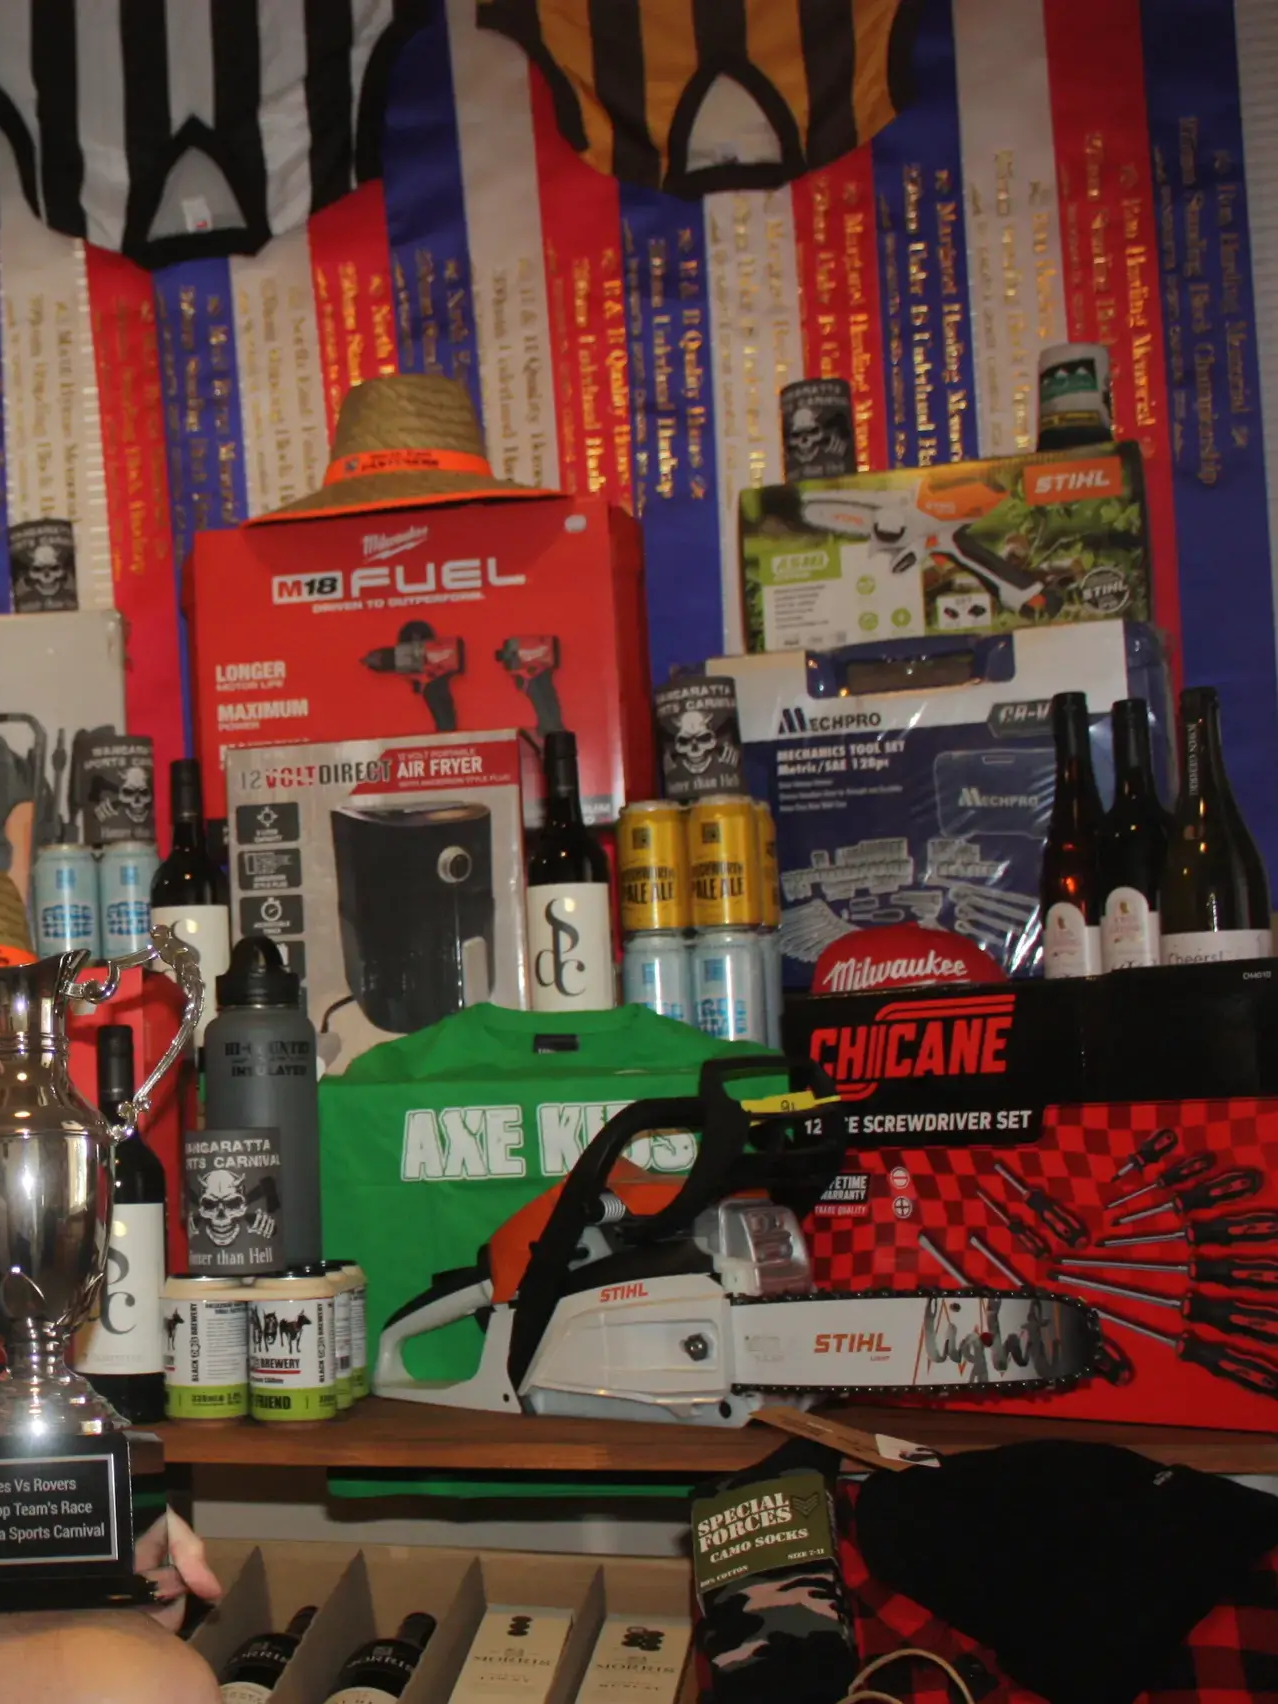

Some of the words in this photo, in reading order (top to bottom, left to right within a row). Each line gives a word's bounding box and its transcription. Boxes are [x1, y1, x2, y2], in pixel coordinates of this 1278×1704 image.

[1034, 468, 1111, 494] STIHL
[277, 574, 339, 599] M18
[350, 557, 527, 599] FUEL
[1082, 579, 1130, 602] STIHL
[365, 599, 386, 610] TO
[215, 660, 288, 684] LONGER
[217, 698, 310, 722] MAXIMUM
[776, 706, 883, 735] MECHPRO
[318, 760, 392, 786] DIRECT
[396, 761, 425, 779] AIR
[428, 756, 484, 777] FRYER
[957, 786, 1039, 809] MECHPRO
[822, 949, 969, 992] Milwaukee
[809, 1010, 1015, 1087] CHICANE
[863, 1113, 993, 1134] SCREWDRIVER
[995, 1110, 1033, 1130] SET
[401, 1104, 527, 1183] AXE
[216, 1248, 245, 1266] than
[248, 1246, 273, 1264] Hell
[599, 1282, 649, 1303] STIHL
[813, 1332, 892, 1354] STIHL
[260, 1358, 301, 1369] BREWERY
[14, 1479, 31, 1492] Vs
[33, 1478, 77, 1492] Rovers
[13, 1500, 58, 1516] Team's
[60, 1500, 93, 1515] Race
[697, 1491, 791, 1538] SPECIAL
[8, 1525, 51, 1544] Sports
[53, 1522, 105, 1539] Carnival
[698, 1506, 793, 1554] FORCES
[709, 1541, 753, 1564] CAMO
[754, 1528, 810, 1549] SOCKS
[787, 1550, 809, 1561] SIZE
[473, 1654, 552, 1668] MORRIS
[596, 1662, 677, 1675] MORRIS
